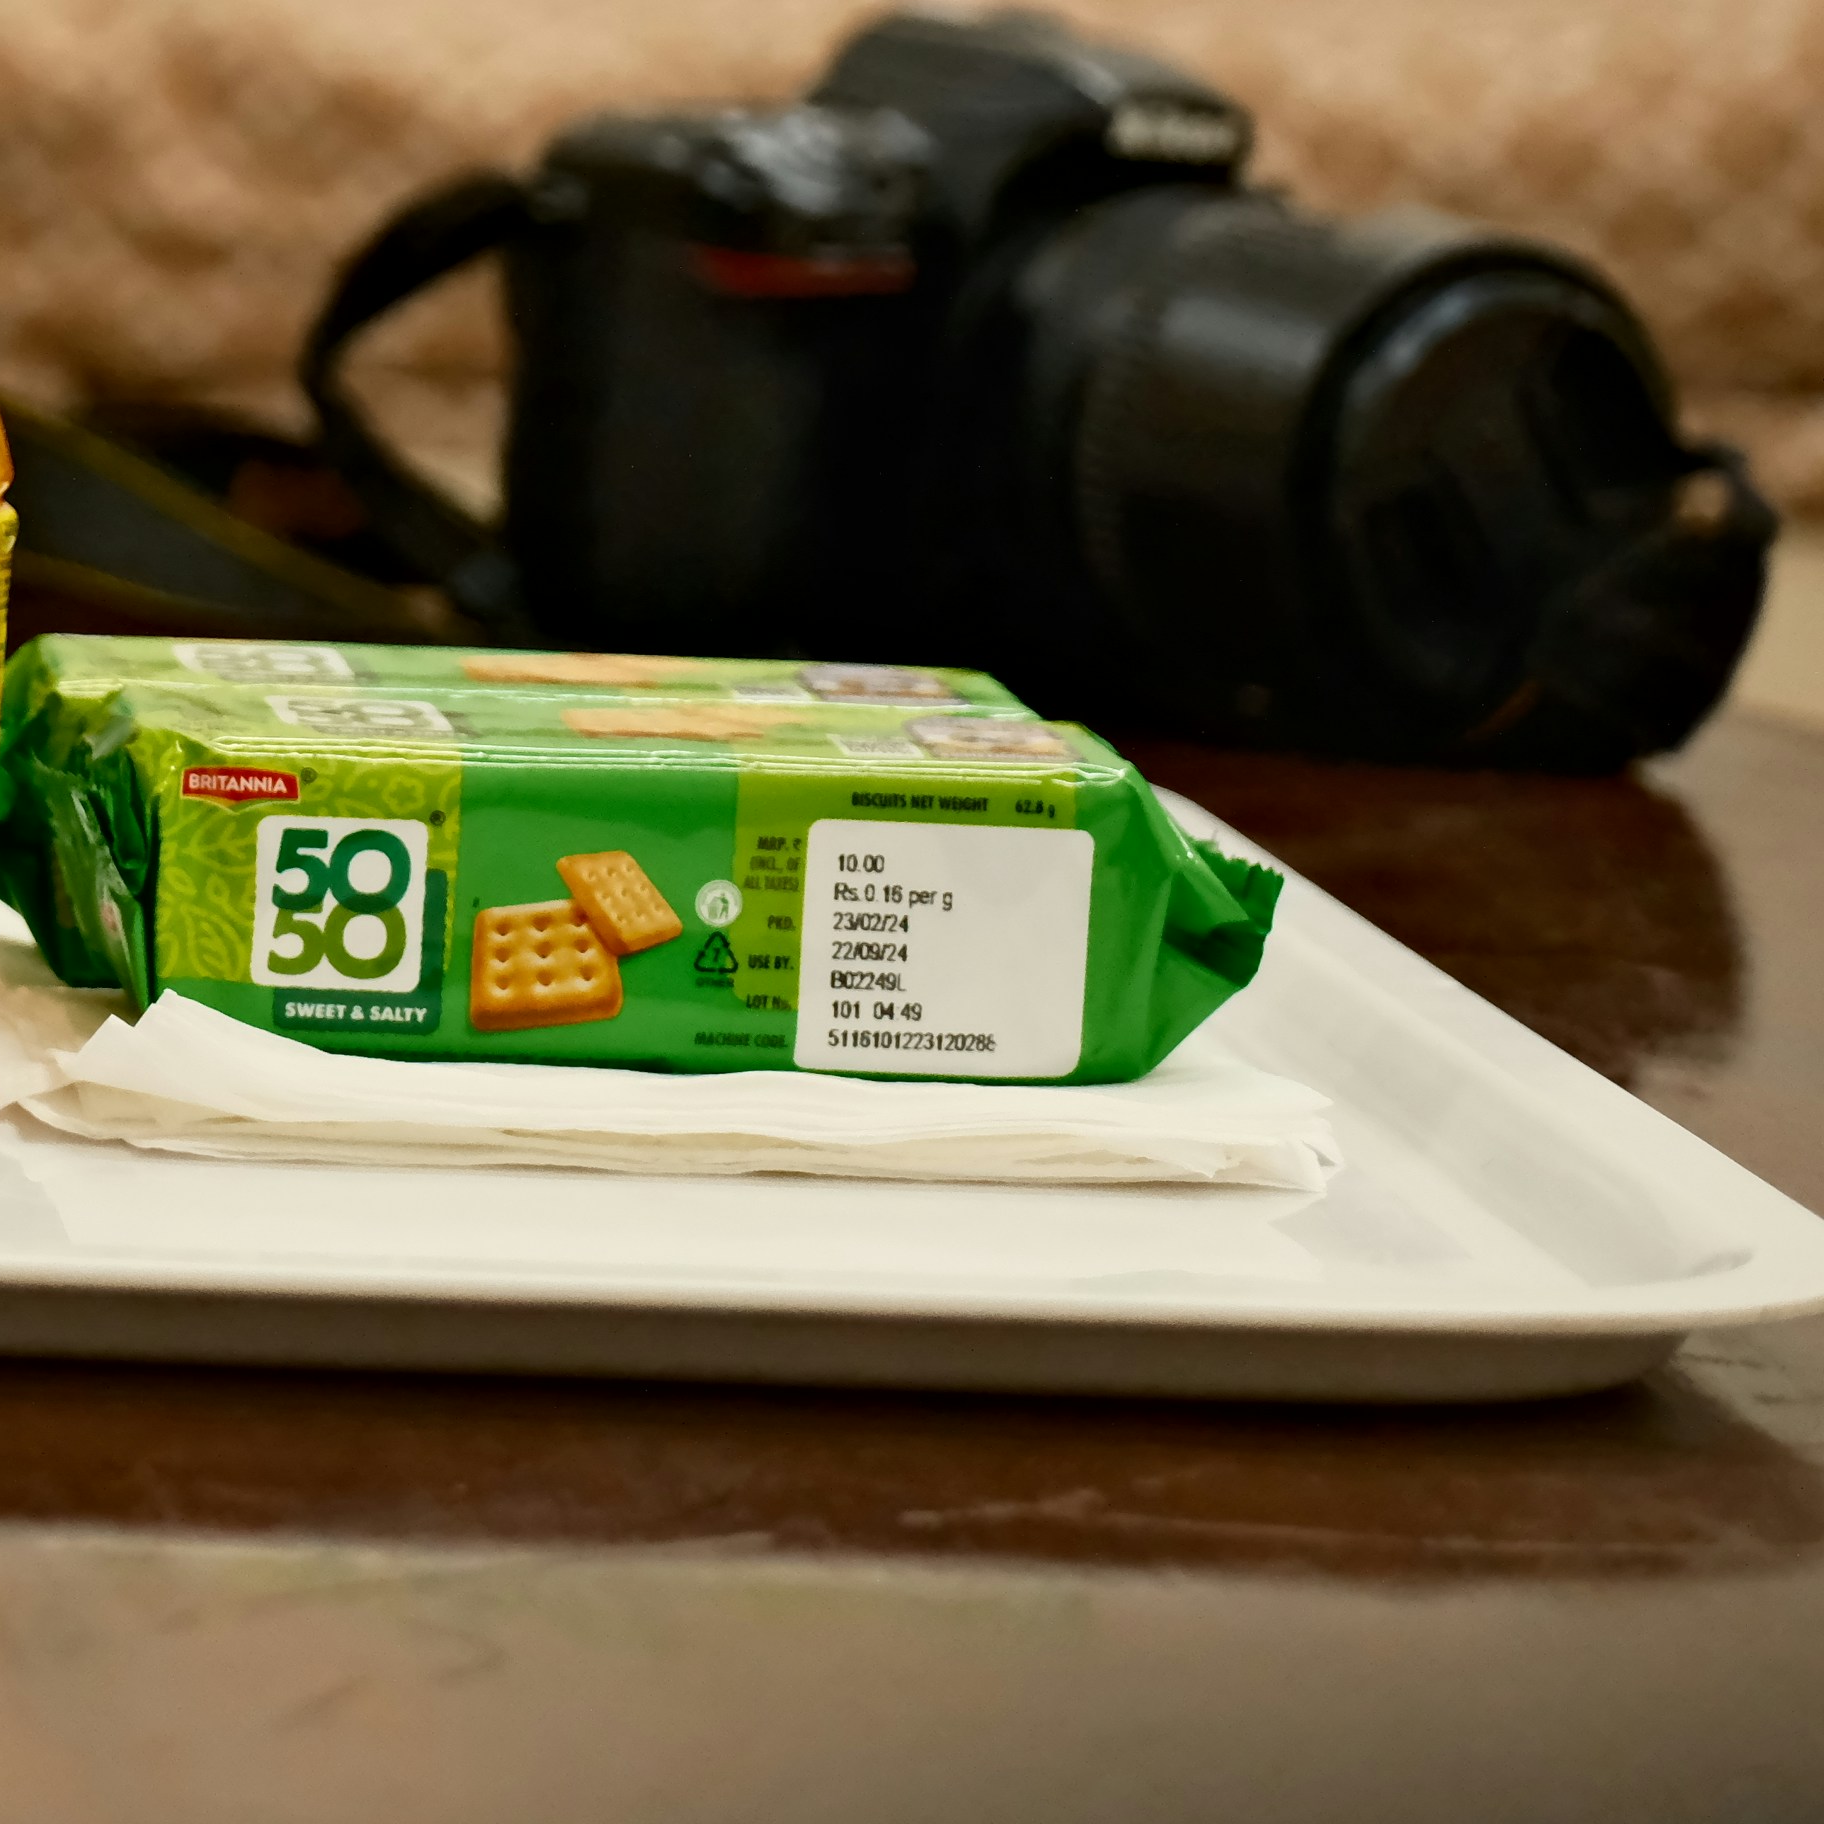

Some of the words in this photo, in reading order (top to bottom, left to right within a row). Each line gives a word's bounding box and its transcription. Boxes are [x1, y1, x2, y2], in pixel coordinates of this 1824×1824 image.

[188, 773, 287, 794] BRITANNIA
[851, 792, 907, 809] BISCUITS
[910, 794, 933, 810] NET
[938, 796, 989, 814] WEIGHT
[1015, 799, 1043, 815] 62.8
[271, 828, 412, 915] 50
[838, 853, 885, 873] 10.00
[908, 890, 938, 909] per
[942, 891, 953, 911] g
[832, 912, 909, 933] 23/02/24
[267, 894, 407, 980] 50
[748, 954, 770, 969] USE
[774, 955, 794, 970] BY.
[831, 941, 908, 962] 22/09/24
[830, 969, 907, 992] B02249L
[746, 994, 768, 1009] LOT
[832, 1000, 860, 1020] 101
[873, 1001, 923, 1021] 04:49
[285, 1002, 348, 1020] SWEET
[350, 1004, 364, 1021] &
[367, 1005, 428, 1023] SALTY
[694, 1031, 750, 1047] MACHINE
